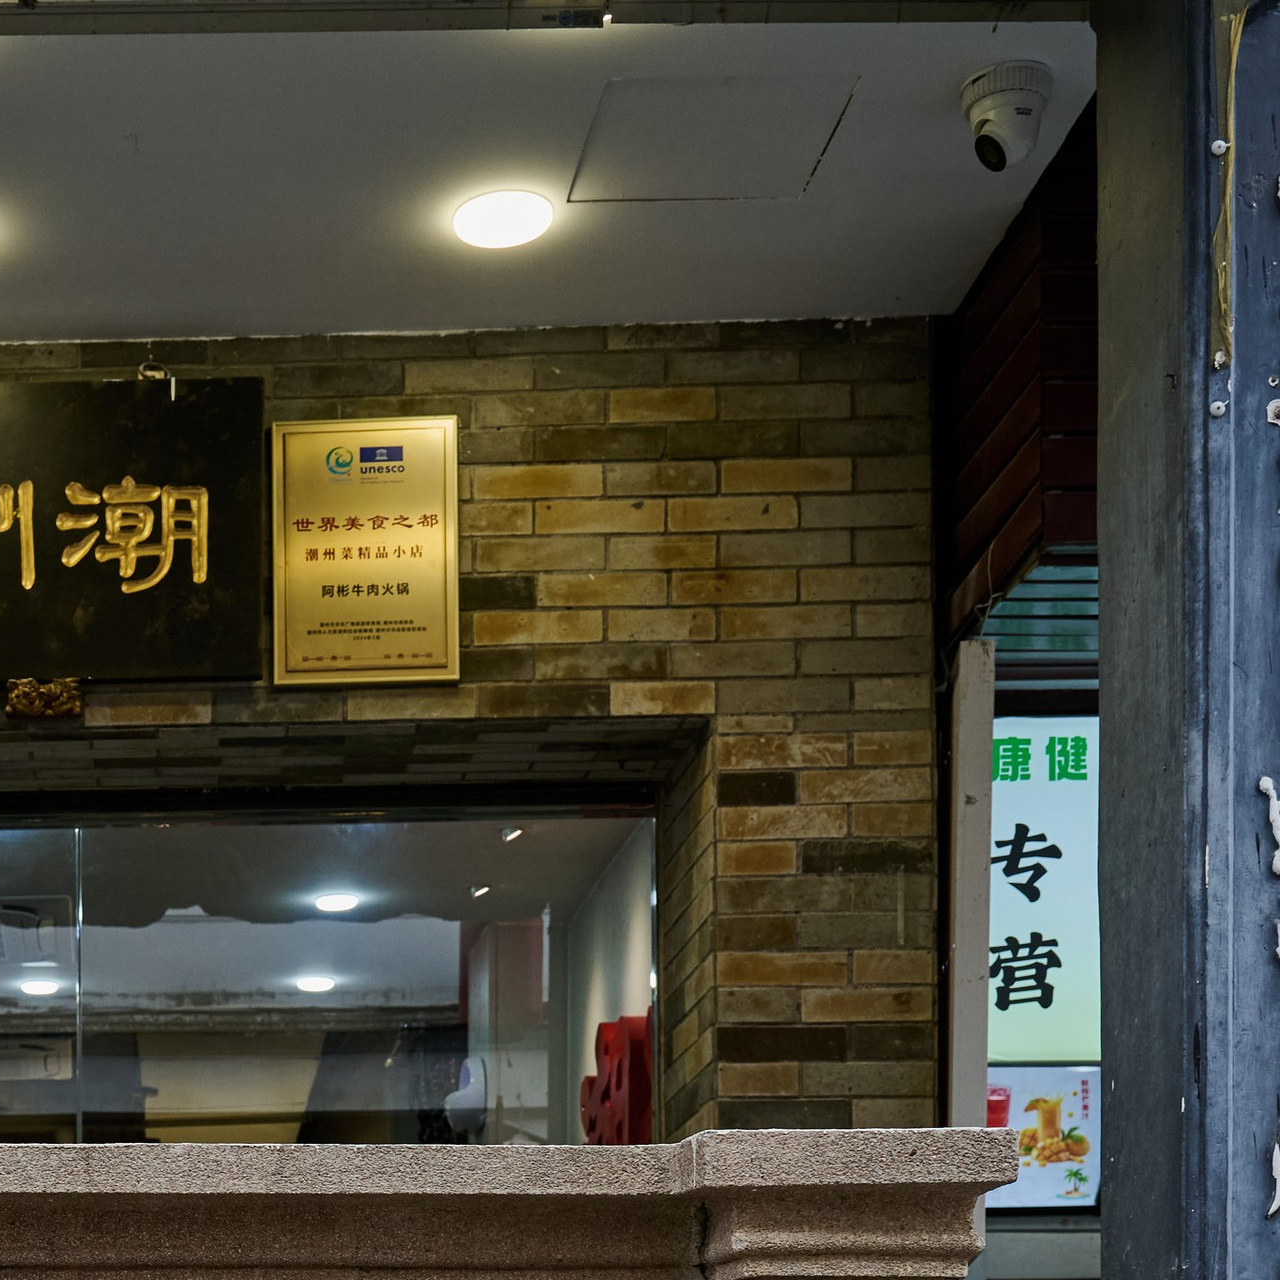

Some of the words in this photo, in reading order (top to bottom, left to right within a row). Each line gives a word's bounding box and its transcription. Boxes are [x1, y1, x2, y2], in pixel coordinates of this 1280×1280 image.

[359, 463, 406, 475] unesco
[292, 513, 440, 533] 世界美食之都
[305, 544, 424, 563] 潮州菜精品小店
[321, 581, 410, 599] 阿彬牛肉火锅
[989, 822, 1063, 1012] 专营
